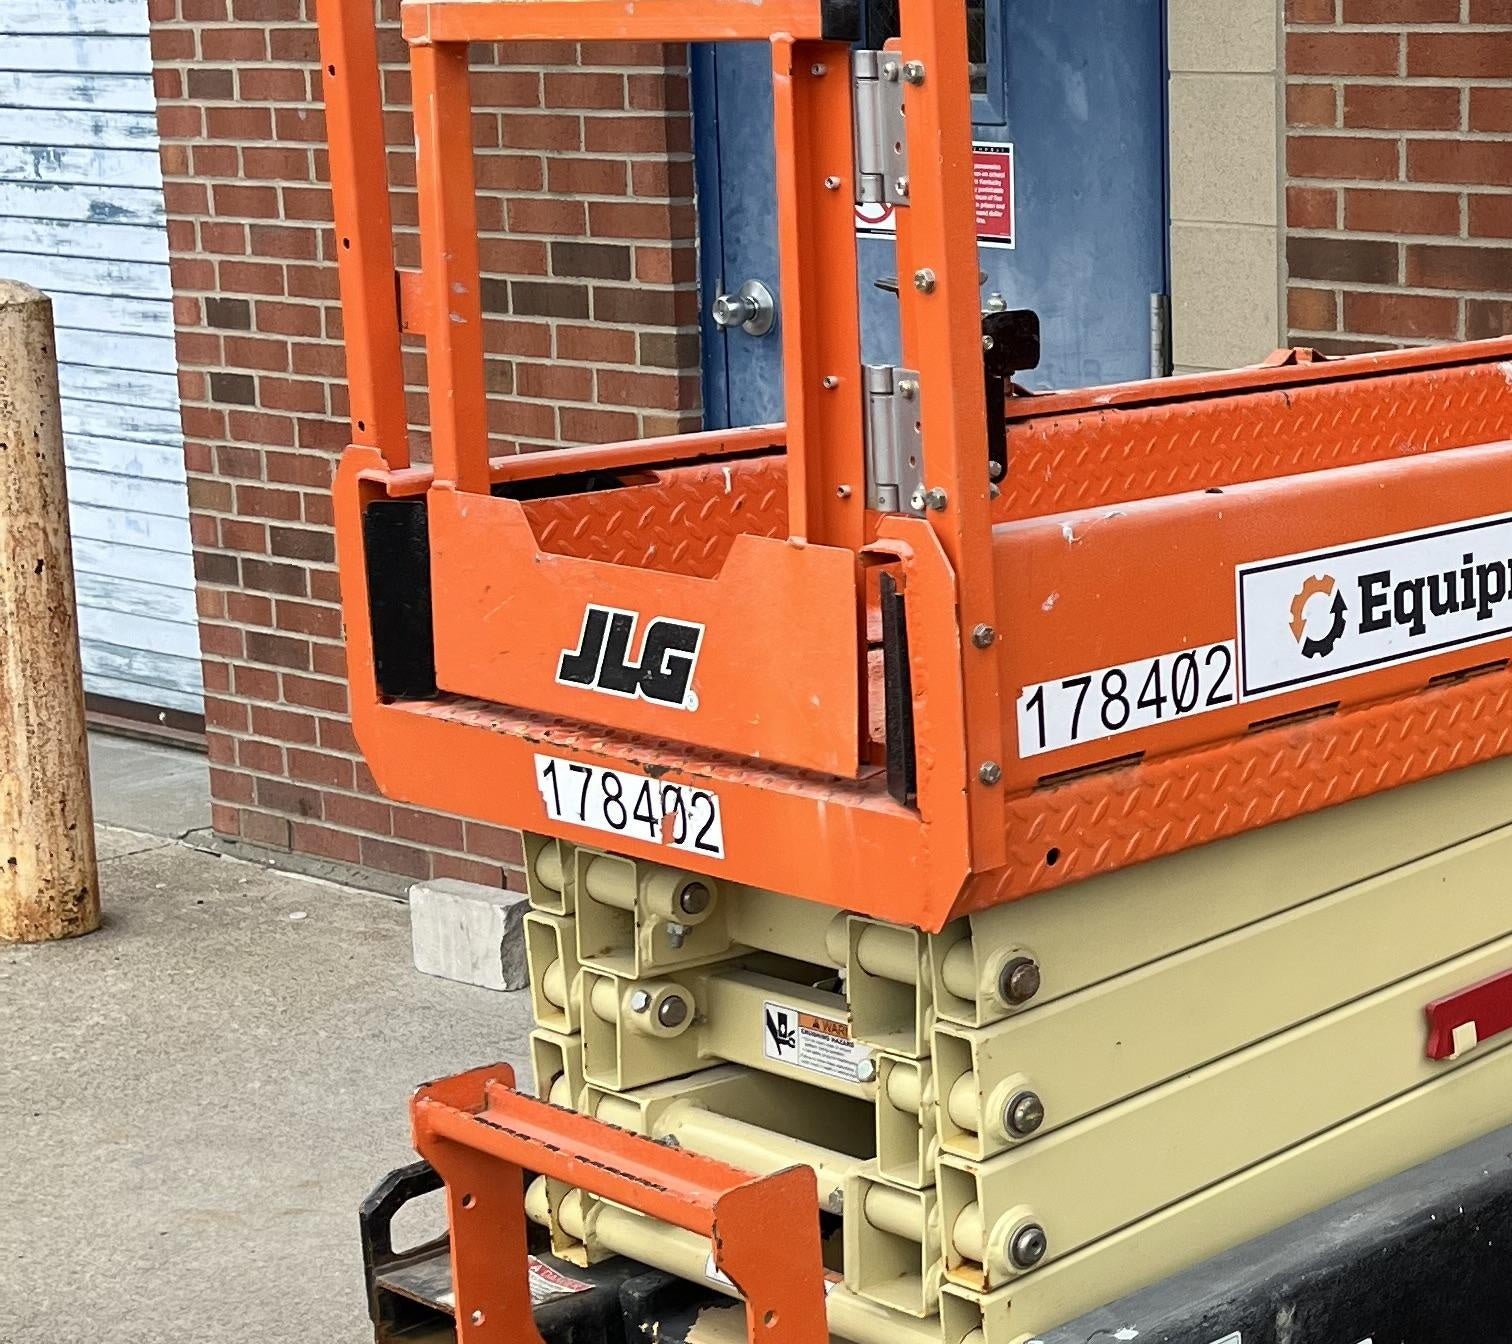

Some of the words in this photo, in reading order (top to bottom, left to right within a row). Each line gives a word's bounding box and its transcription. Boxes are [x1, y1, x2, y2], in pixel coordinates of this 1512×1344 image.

[558, 607, 702, 706] JLG
[1025, 644, 1233, 749] 178402
[542, 759, 720, 854] 178402
